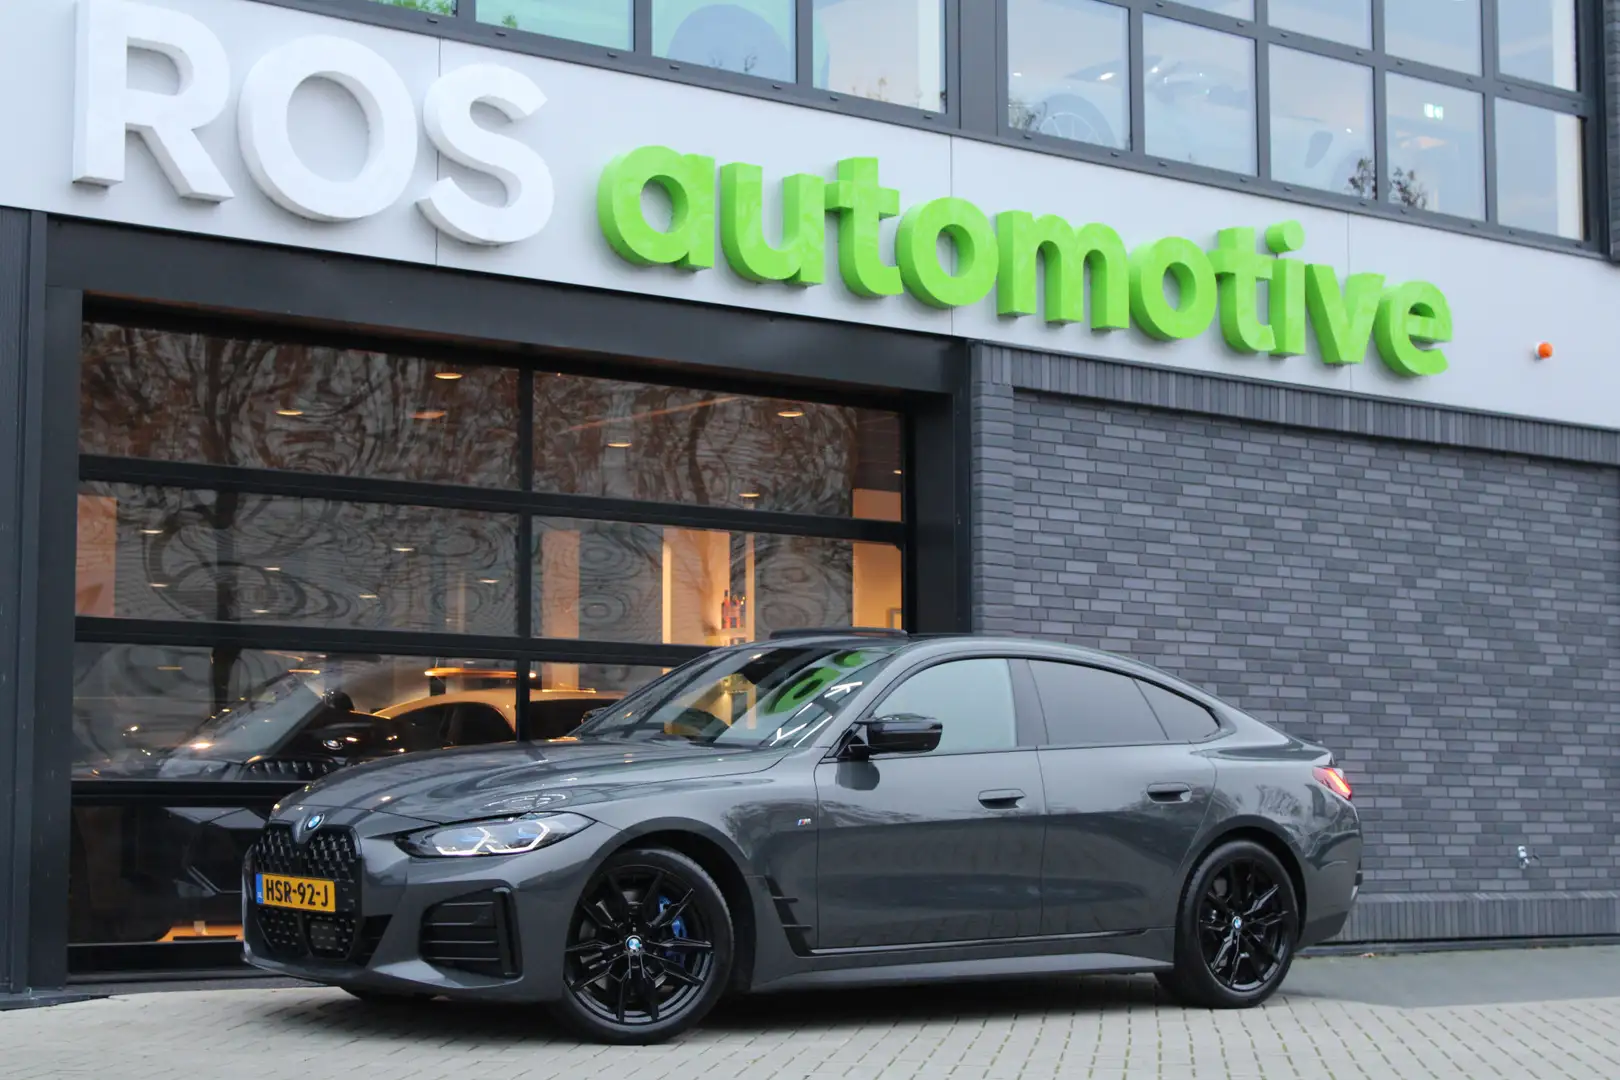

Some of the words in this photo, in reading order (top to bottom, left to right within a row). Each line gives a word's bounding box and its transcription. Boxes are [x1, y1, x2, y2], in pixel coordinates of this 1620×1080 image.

[73, 0, 555, 246] ROS
[598, 144, 1453, 377] automotive
[265, 878, 329, 907] HSR-92-J
